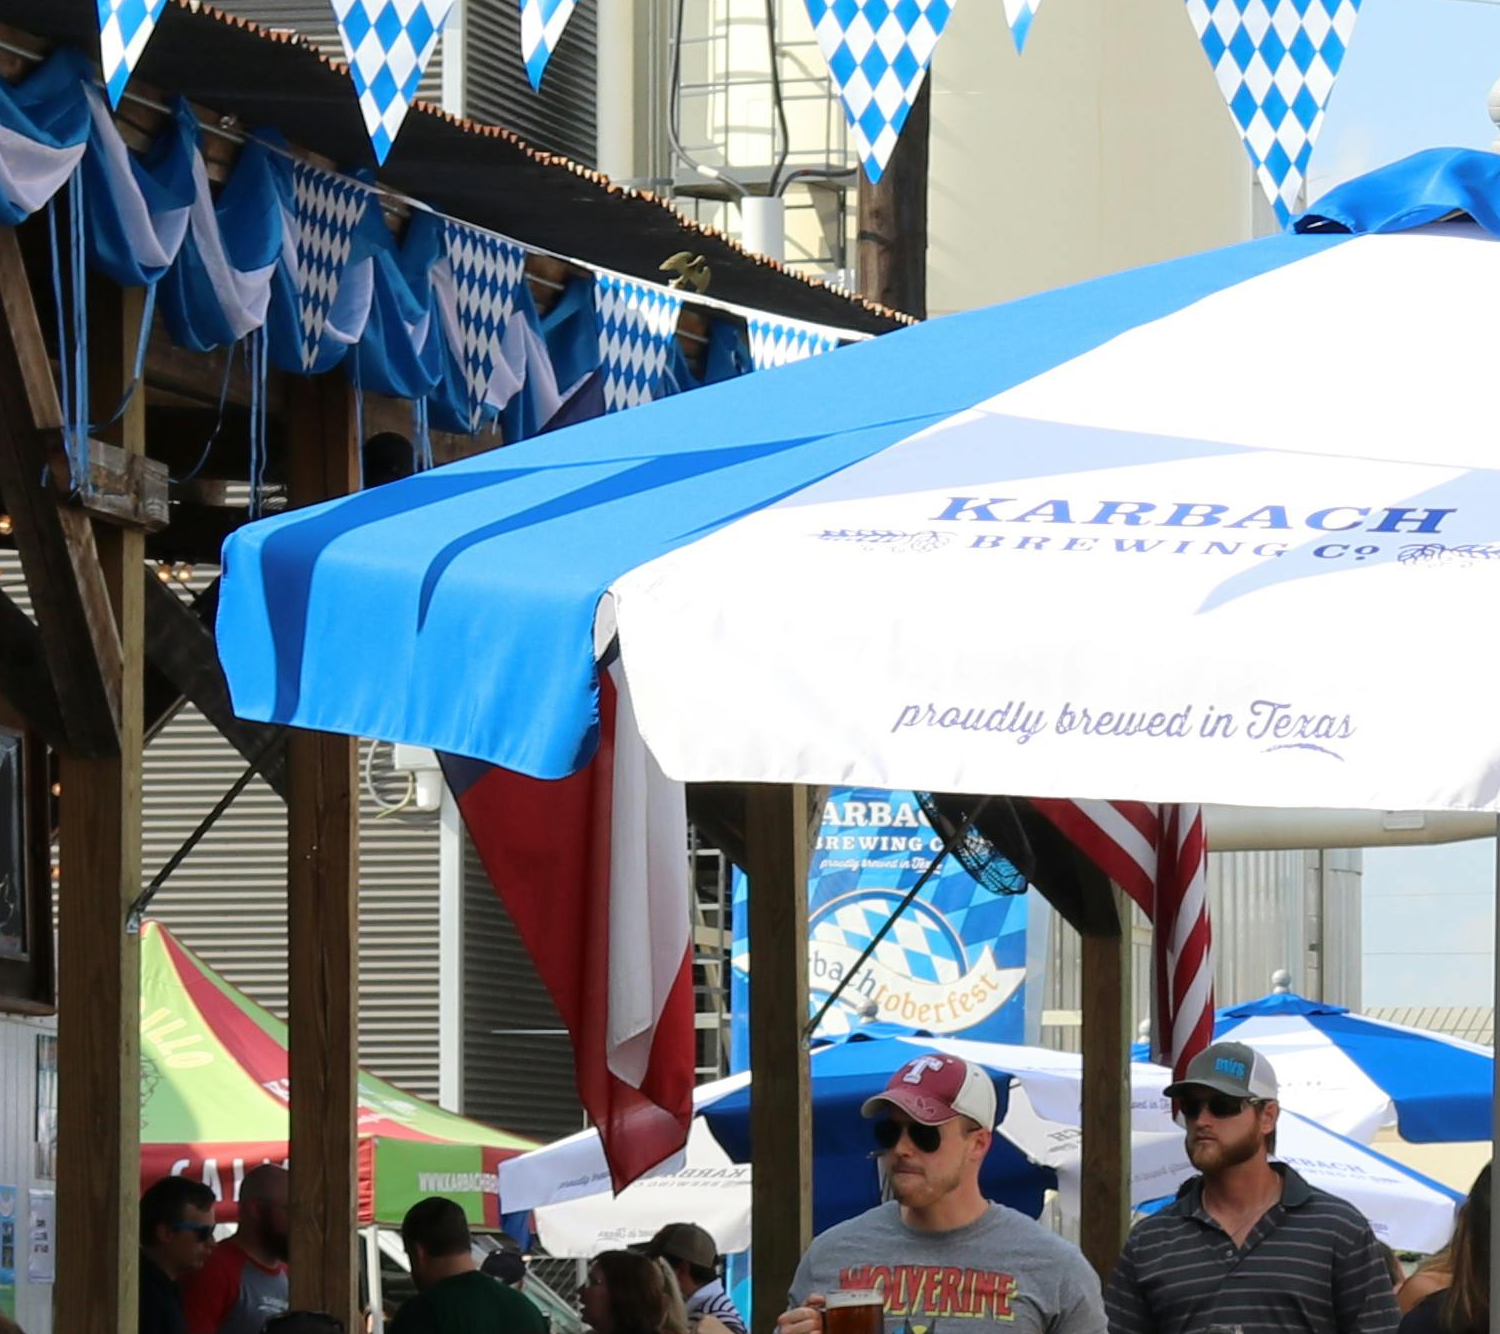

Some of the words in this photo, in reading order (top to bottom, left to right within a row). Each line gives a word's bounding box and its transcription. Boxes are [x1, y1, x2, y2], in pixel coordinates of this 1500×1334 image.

[928, 496, 1458, 536] KARBACH
[966, 535, 1289, 559] BREWING
[891, 699, 1046, 746] proudly
[1055, 701, 1191, 738] brewed
[1198, 704, 1239, 740] in
[1245, 700, 1357, 743] Texas
[821, 801, 932, 828] ARBA
[928, 835, 945, 852] C
[807, 950, 999, 1025] bachtoberfest
[840, 1265, 1017, 1320] WOLVERINE
